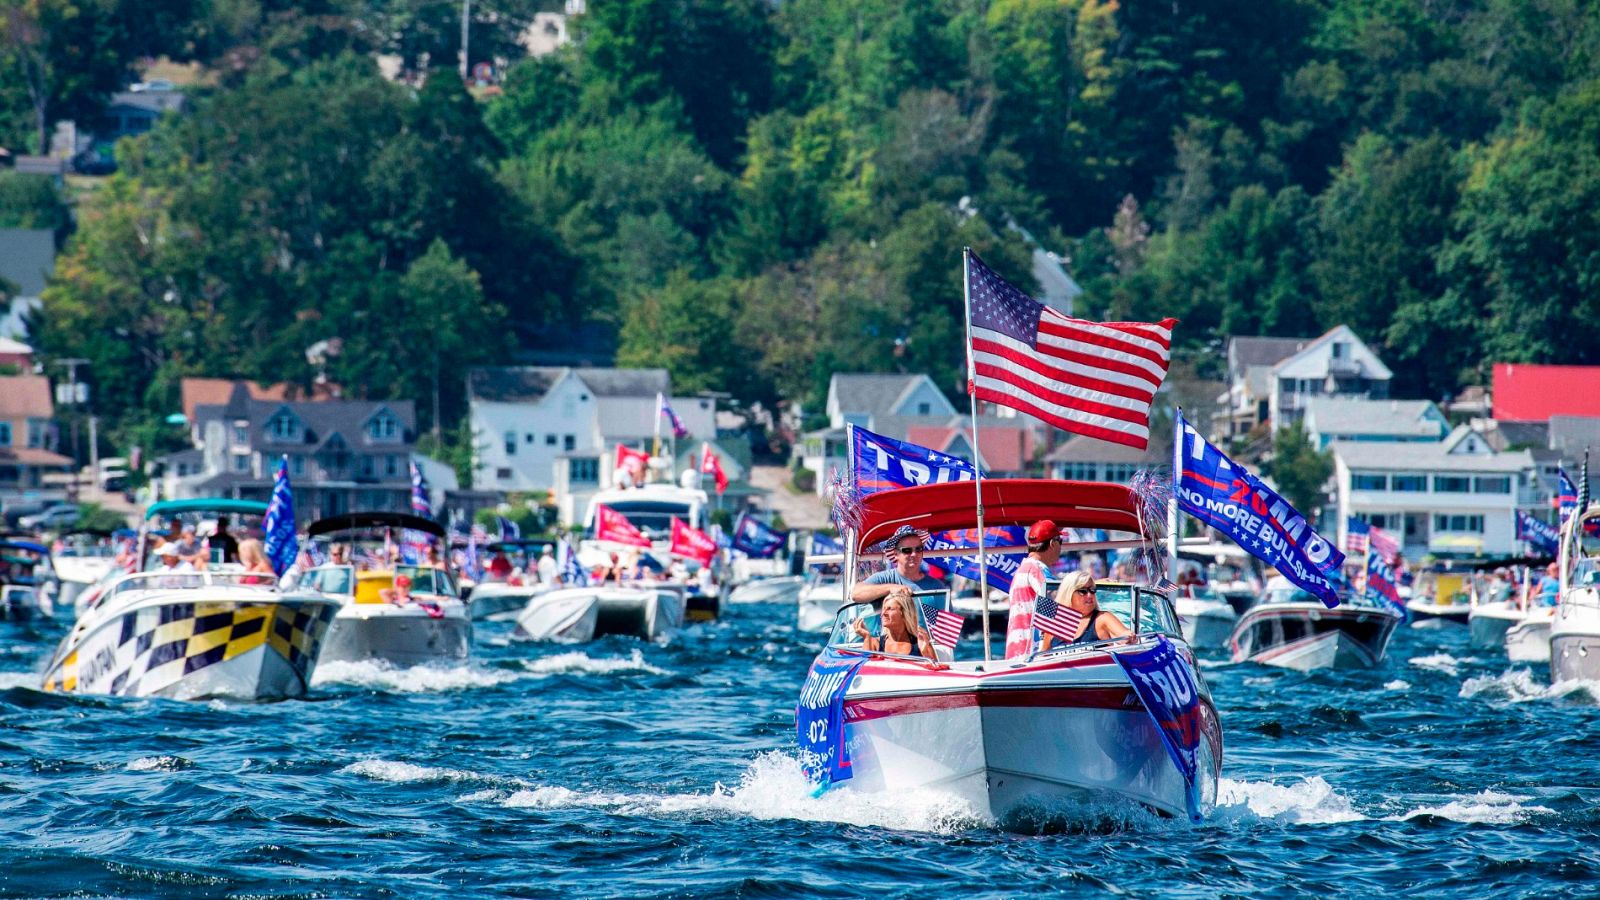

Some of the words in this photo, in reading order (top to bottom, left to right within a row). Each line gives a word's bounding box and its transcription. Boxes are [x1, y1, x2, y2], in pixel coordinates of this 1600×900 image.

[866, 440, 987, 487] TRU
[1177, 486, 1204, 507] NO
[1206, 500, 1257, 535] MORE
[1258, 524, 1332, 590] BULLSHIT
[1131, 653, 1198, 709] TRU
